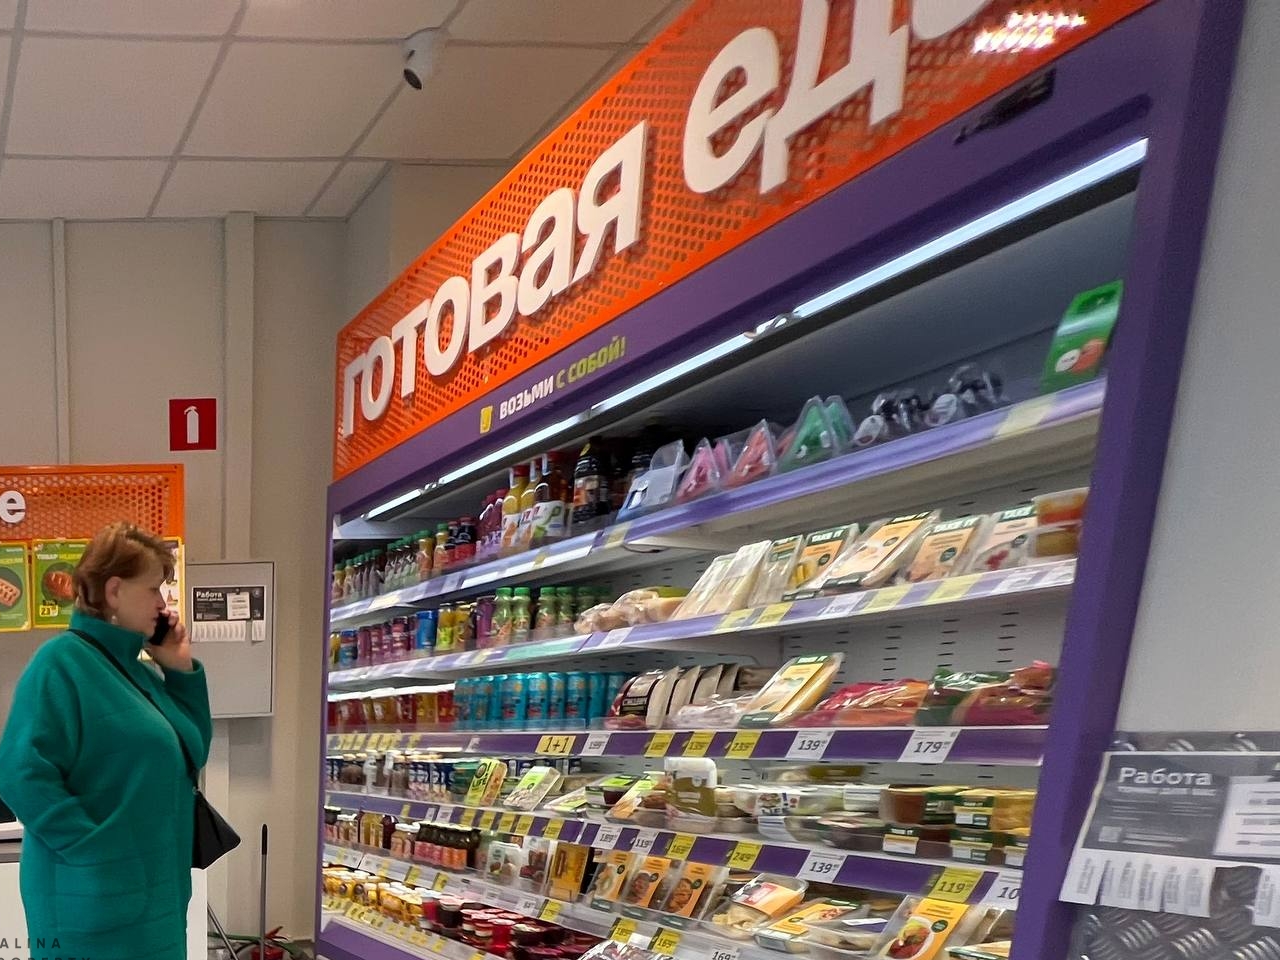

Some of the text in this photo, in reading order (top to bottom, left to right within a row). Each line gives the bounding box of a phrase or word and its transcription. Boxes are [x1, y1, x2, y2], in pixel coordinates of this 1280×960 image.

[343, 119, 648, 439] готовая
[499, 336, 626, 420] ВОЗЬМИ С СОБОЙ!
[196, 591, 222, 599] Работа
[543, 737, 571, 753] 1+1
[798, 740, 821, 751] 139
[914, 741, 943, 754] 179
[1118, 766, 1213, 786] Работа
[809, 861, 833, 874] 139
[937, 881, 965, 894] 119
